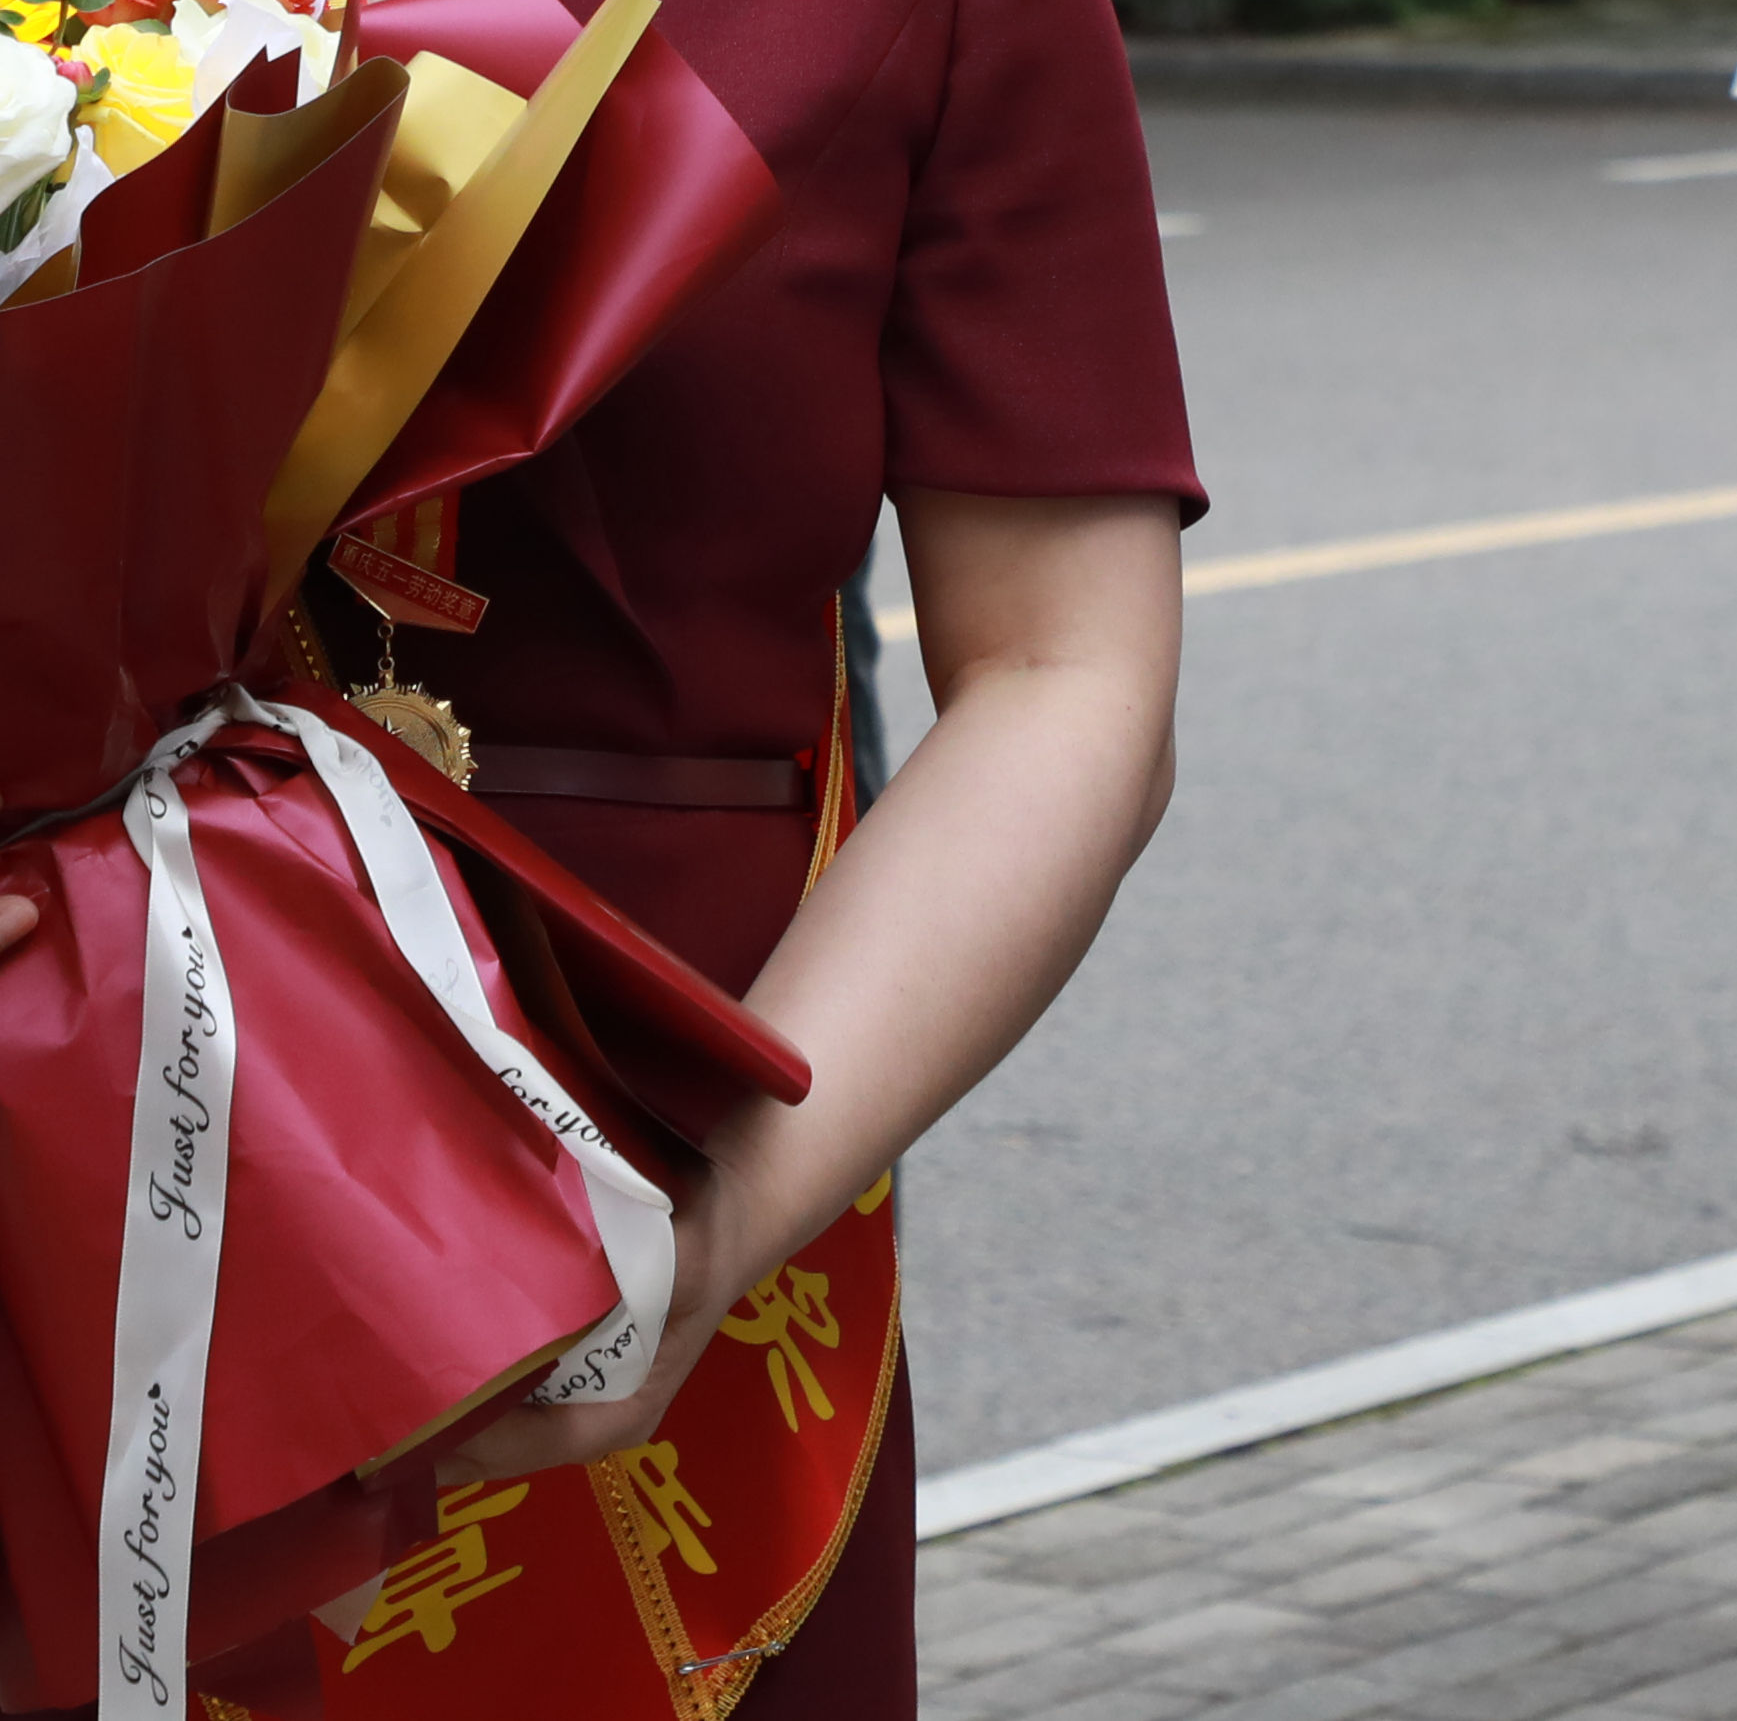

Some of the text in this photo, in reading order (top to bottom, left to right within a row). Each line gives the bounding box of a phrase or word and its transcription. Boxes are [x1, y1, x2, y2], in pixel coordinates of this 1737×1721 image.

[341, 543, 477, 621] 重庆五一劳动奖章
[149, 943, 217, 1241] Just for you
[497, 1066, 554, 1112] for
[555, 1348, 606, 1400] for
[118, 1399, 176, 1706] Just for you
